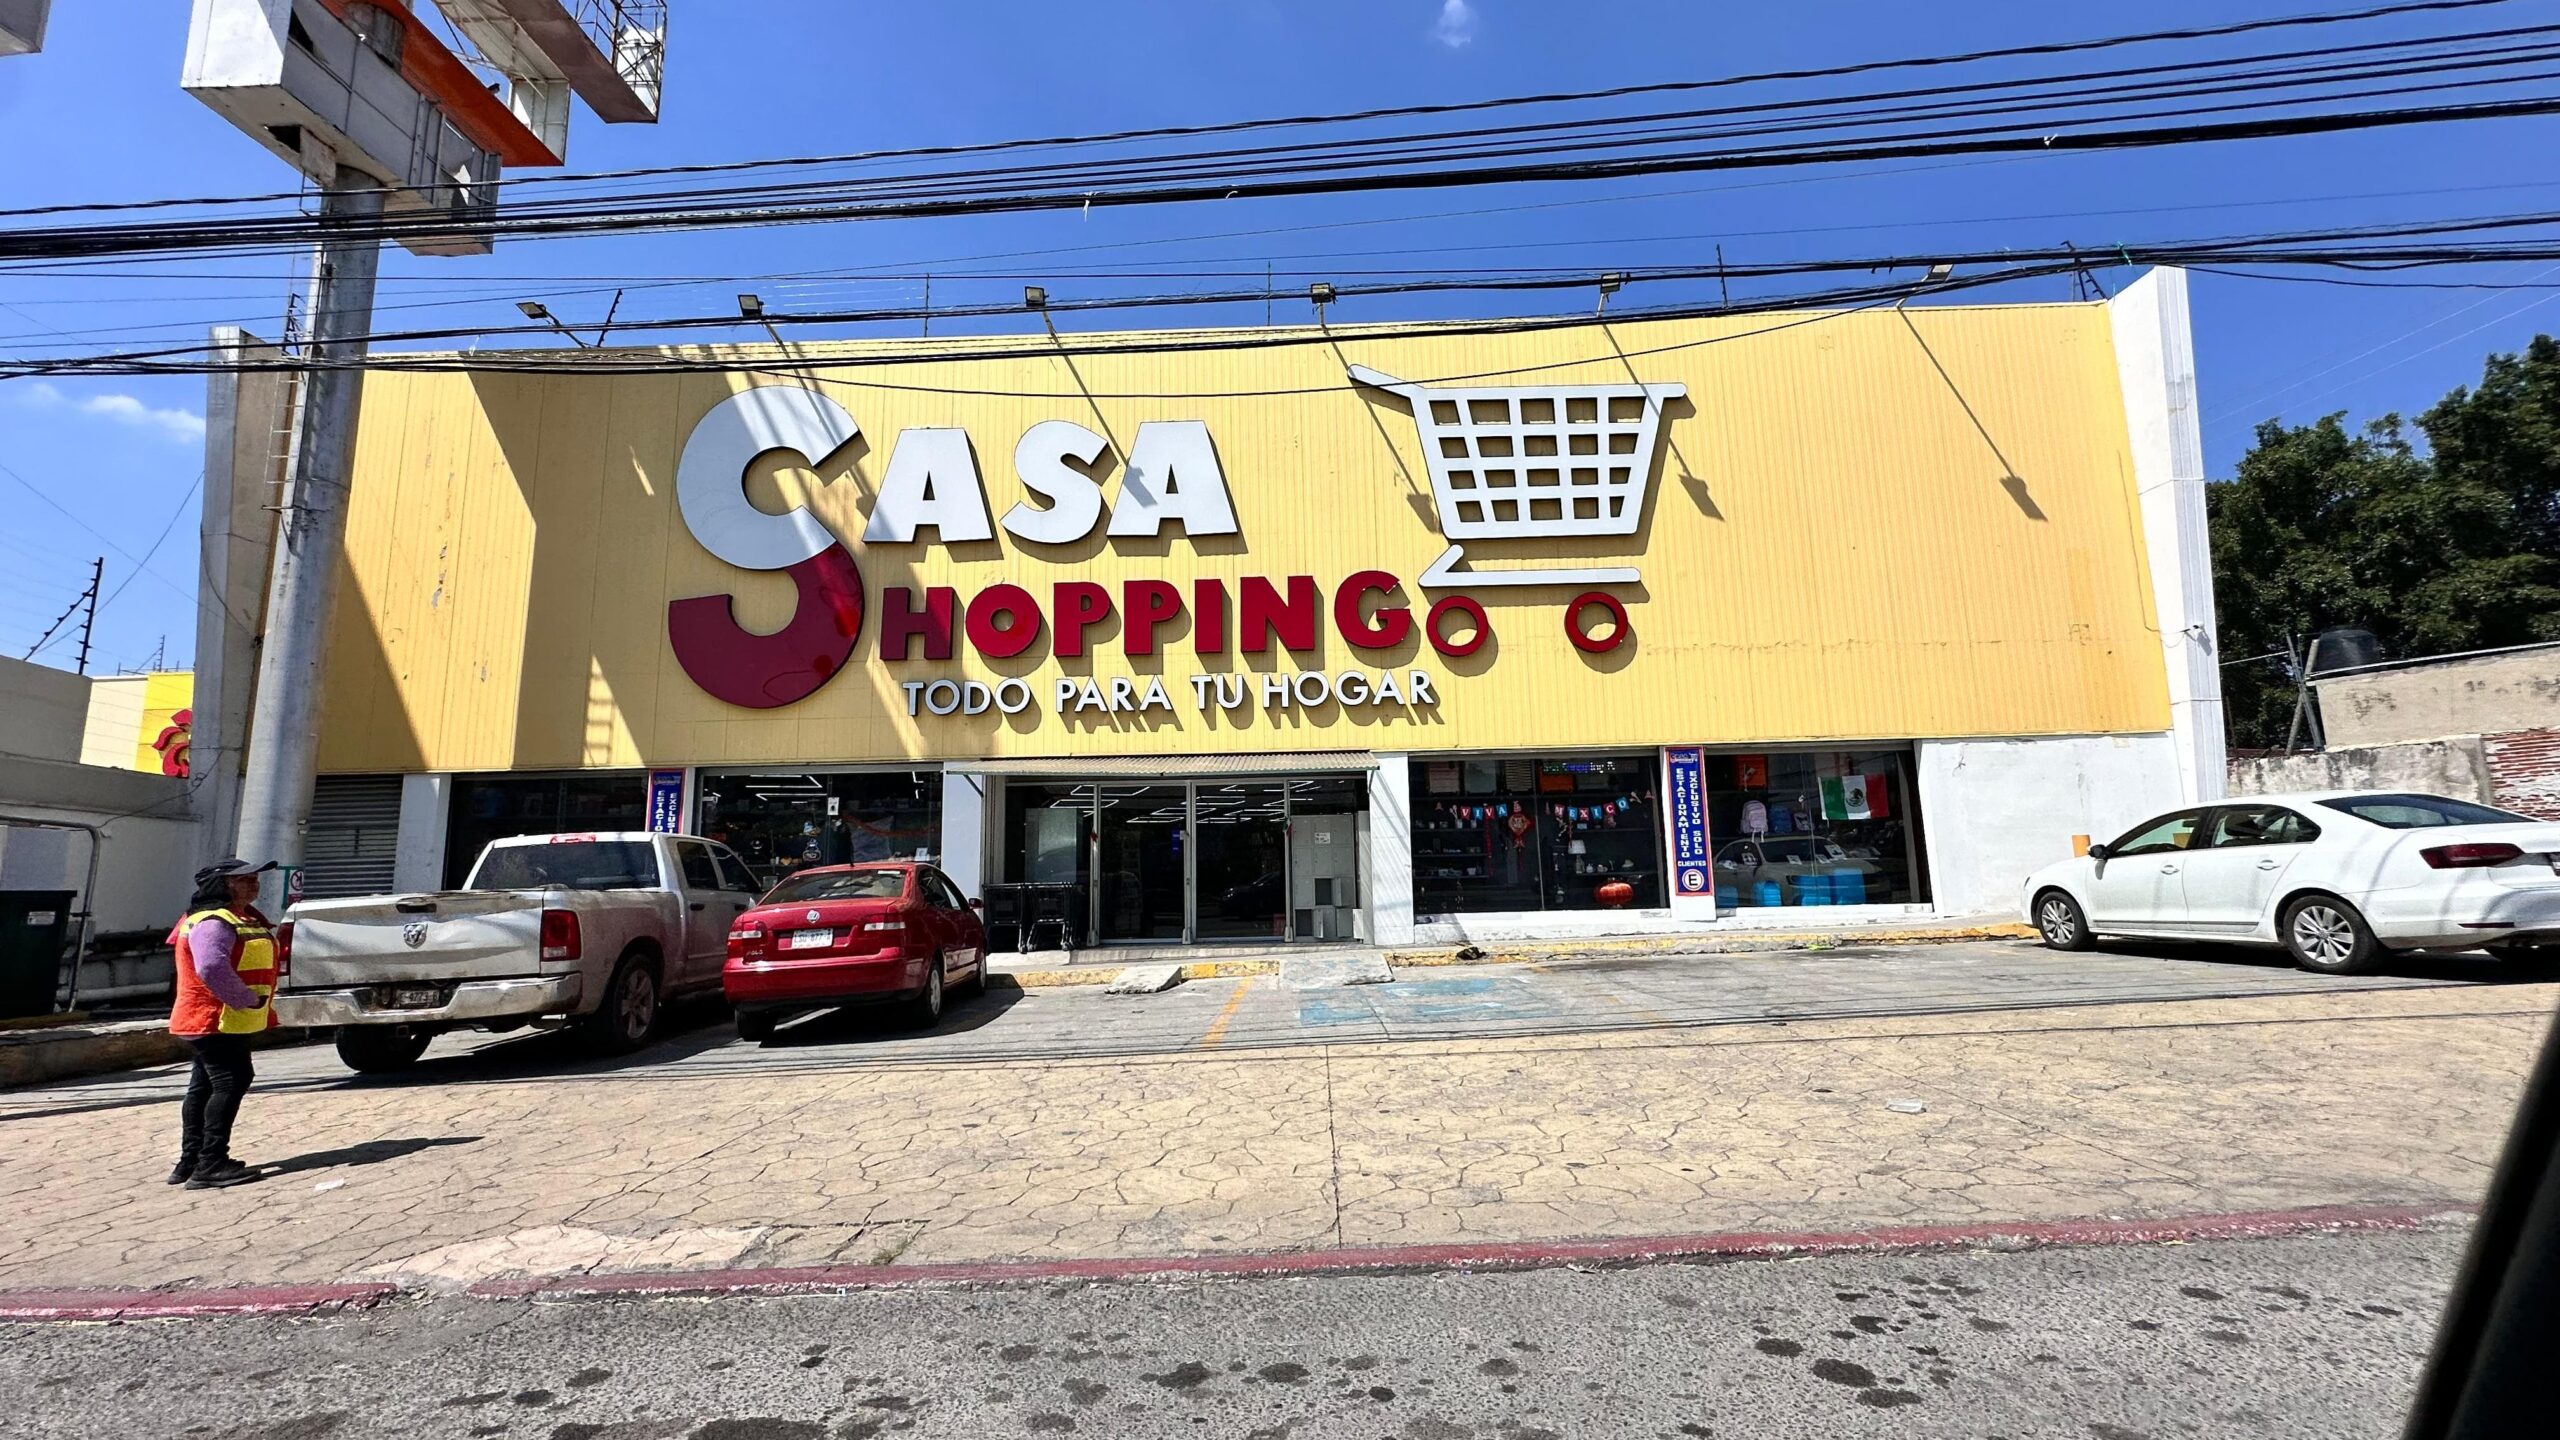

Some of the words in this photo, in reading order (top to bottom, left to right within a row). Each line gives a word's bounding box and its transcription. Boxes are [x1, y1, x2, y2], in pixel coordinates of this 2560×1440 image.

[676, 385, 1238, 570] CASA
[668, 541, 1411, 709] SHOPPING
[902, 676, 1031, 717] TODO
[1055, 674, 1173, 713] PARA
[1190, 673, 1245, 710] TU
[1262, 669, 1436, 708] HOGAR
[1462, 805, 1507, 818] VIVA
[1554, 798, 1628, 819] MEXICO
[1675, 767, 1691, 858] ESTACIONAMIENTO
[1689, 770, 1701, 825] EXCLUSIVO
[1692, 830, 1704, 855] SOLO
[1688, 873, 1699, 886] E
